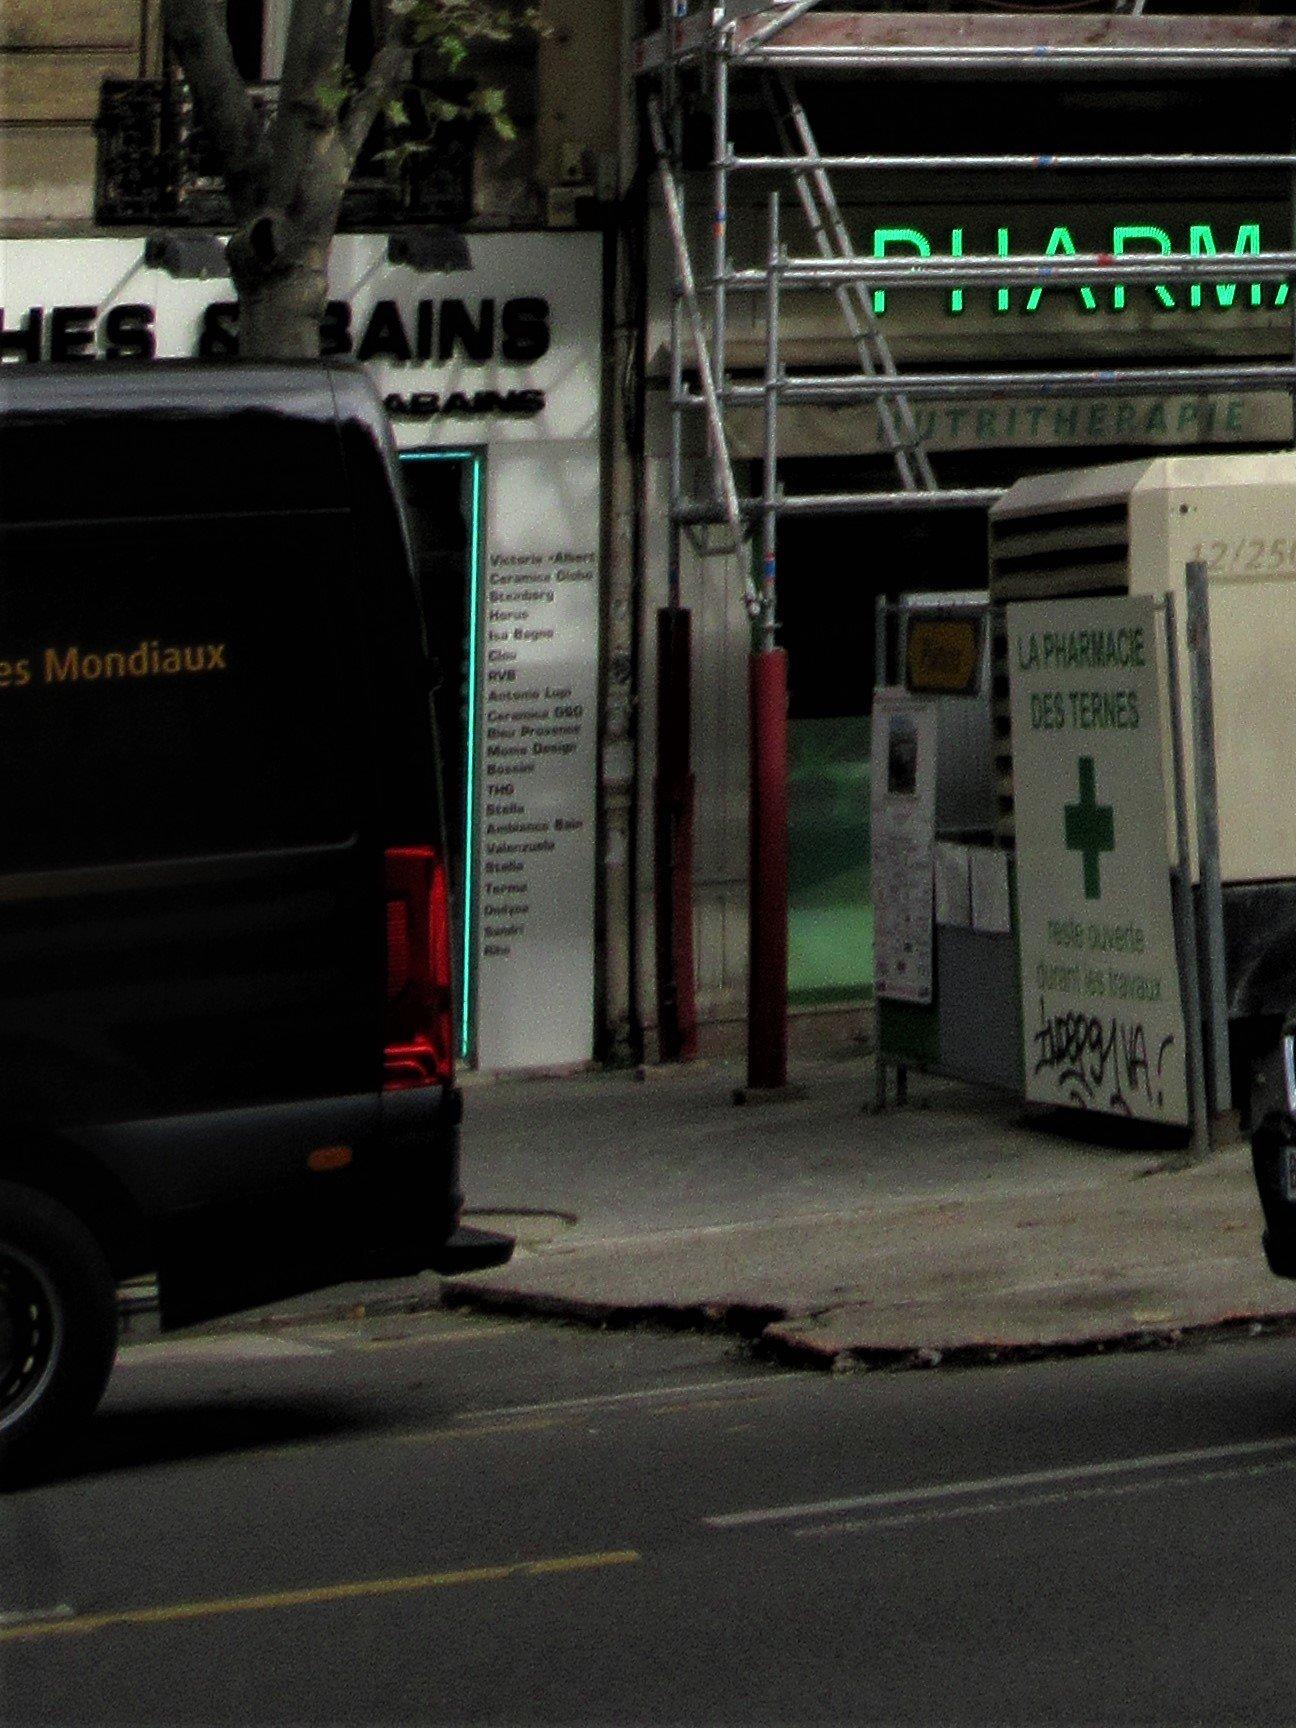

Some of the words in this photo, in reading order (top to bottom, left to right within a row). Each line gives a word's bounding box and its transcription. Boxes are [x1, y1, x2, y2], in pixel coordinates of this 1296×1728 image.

[44, 640, 227, 684] Mondiaux
[1043, 626, 1145, 668] PHARMACIE
[1030, 691, 1065, 729] DES
[1069, 690, 1140, 729] TERNES
